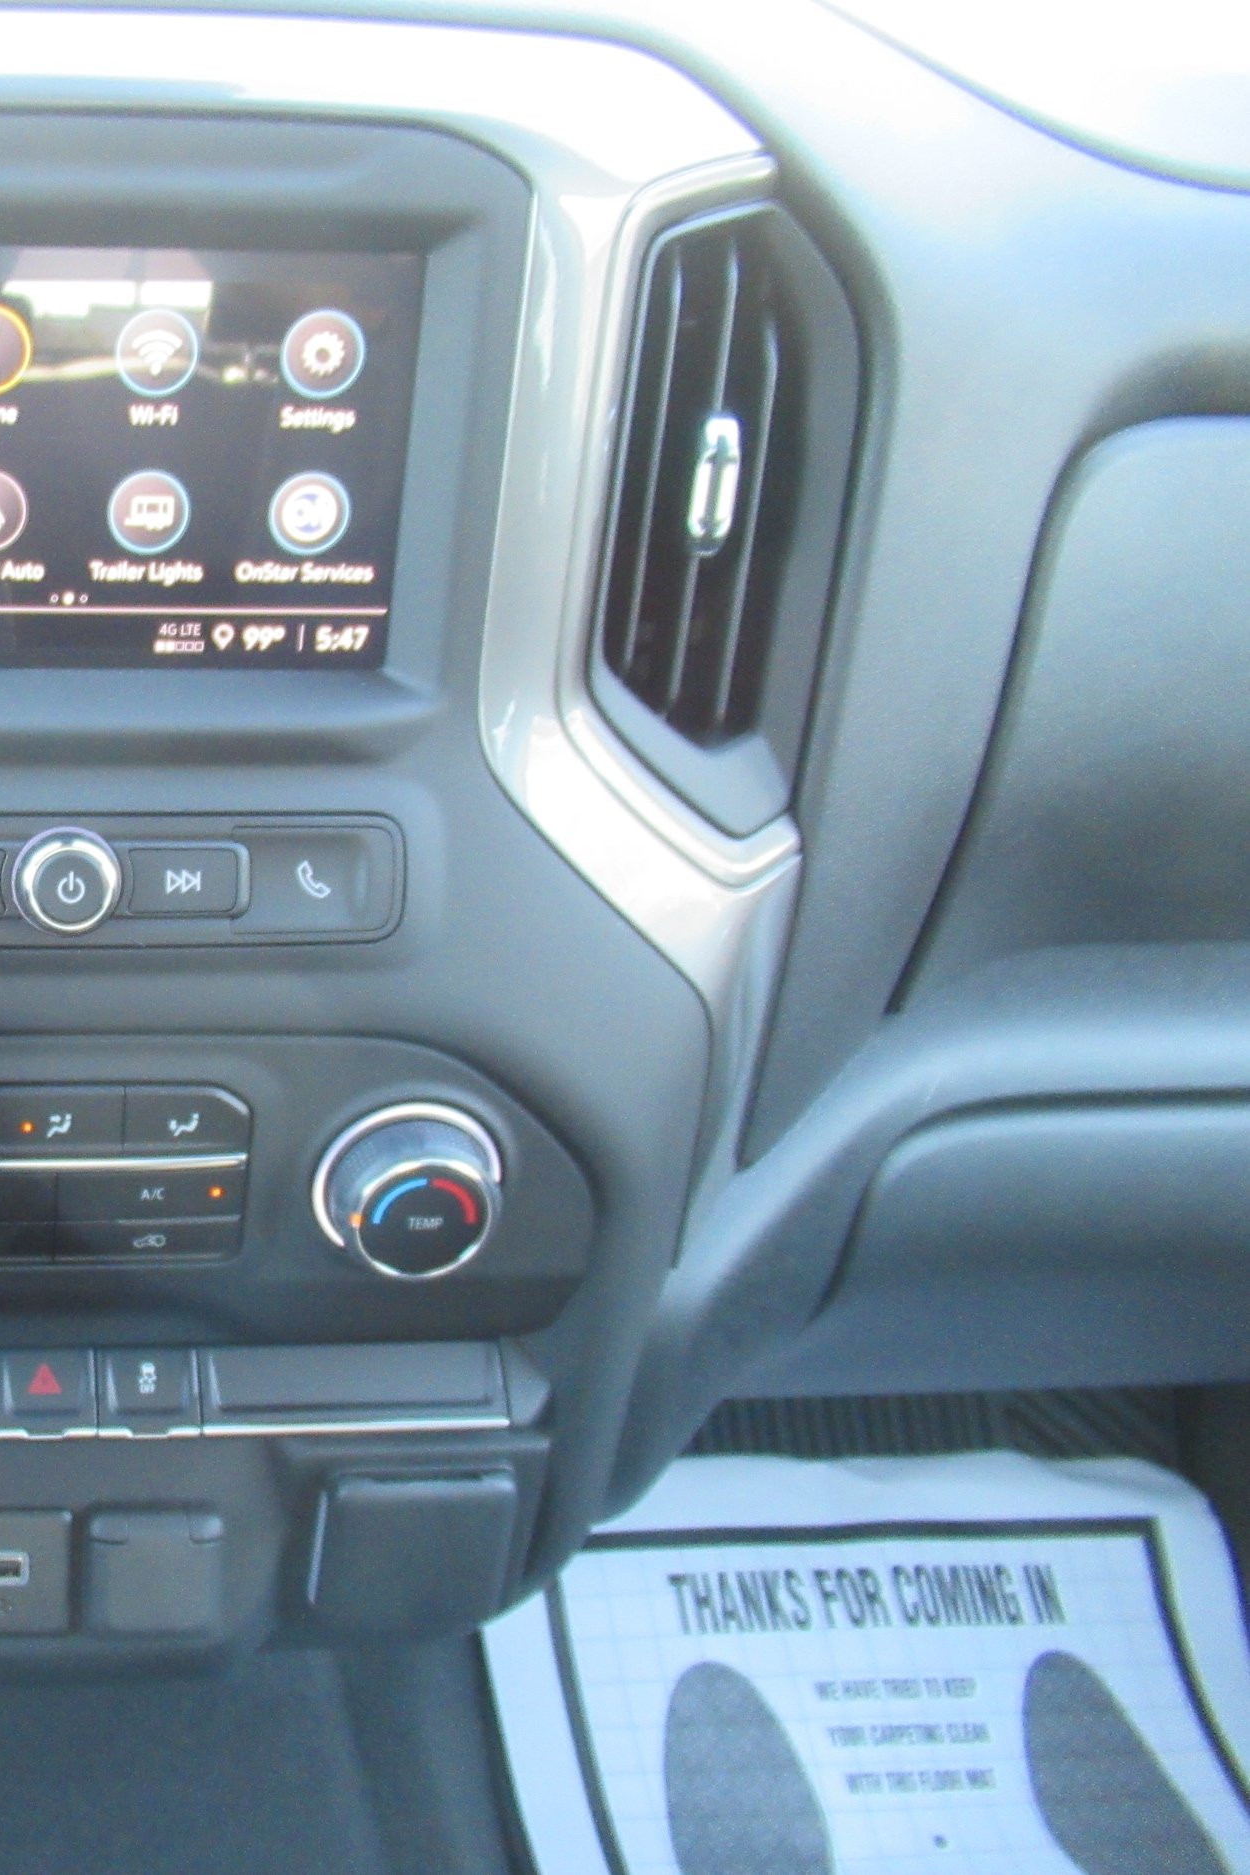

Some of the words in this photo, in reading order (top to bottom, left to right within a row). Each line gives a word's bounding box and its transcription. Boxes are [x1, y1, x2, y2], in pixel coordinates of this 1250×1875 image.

[129, 404, 179, 426] Wi-Fi
[279, 406, 355, 433] Settings
[1, 561, 45, 581] Auto
[89, 560, 146, 582] Trailer
[148, 562, 203, 586] Lights
[235, 561, 298, 583] OnStar
[299, 562, 374, 583] Services
[159, 623, 177, 636] 4G
[180, 623, 201, 636] LTE
[315, 626, 369, 651] 5:47
[141, 1188, 165, 1201] A/C
[408, 1217, 444, 1230] TEMP
[668, 1569, 812, 1635] THANKS
[814, 1566, 893, 1629] FOR
[892, 1563, 1025, 1627] COMING
[1022, 1563, 1069, 1626] IN
